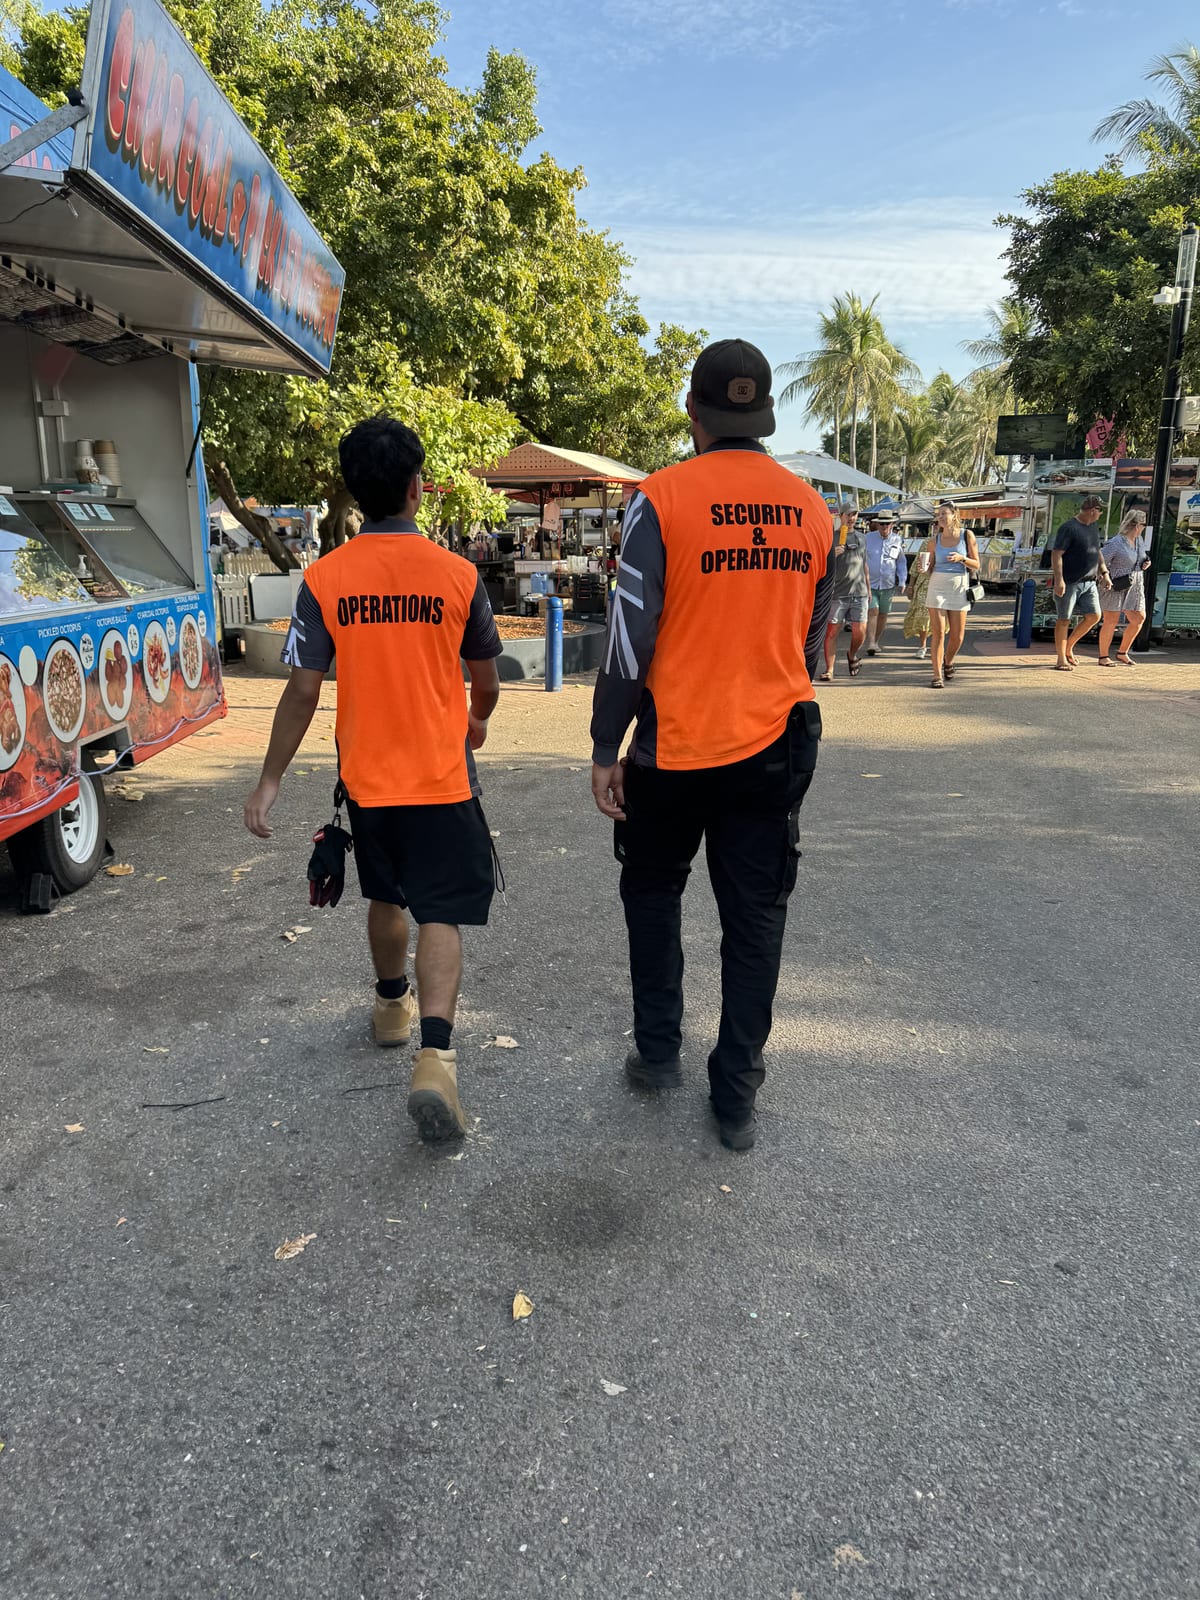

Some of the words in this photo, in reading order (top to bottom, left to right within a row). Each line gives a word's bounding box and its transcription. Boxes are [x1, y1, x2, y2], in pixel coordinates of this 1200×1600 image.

[108, 7, 233, 236] CHARCOAL
[229, 181, 246, 248] &
[710, 503, 803, 527] SECURITY
[752, 527, 767, 545] &
[701, 548, 812, 574] OPERATIONS
[96, 616, 115, 627] OCTOPUS
[115, 614, 128, 624] BALLS
[337, 594, 444, 626] OPERATIONS
[38, 626, 60, 639] PICKLED
[60, 622, 82, 634] OCTOPUS
